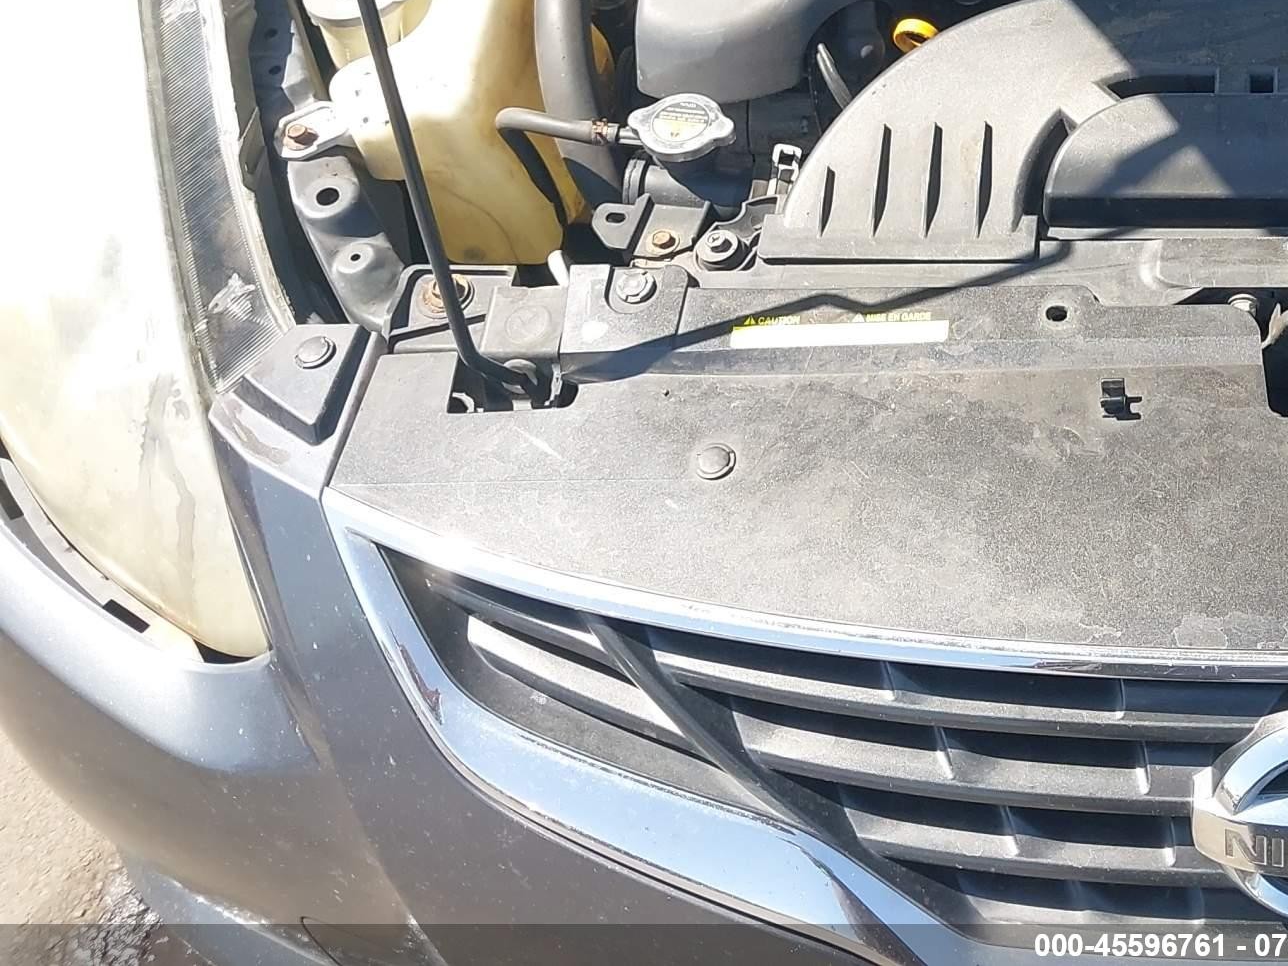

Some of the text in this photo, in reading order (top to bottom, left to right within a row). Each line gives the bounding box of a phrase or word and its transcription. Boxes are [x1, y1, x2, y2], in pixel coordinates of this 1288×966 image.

[757, 315, 801, 326] CAUTION
[865, 311, 932, 323] MISE EN GARDE
